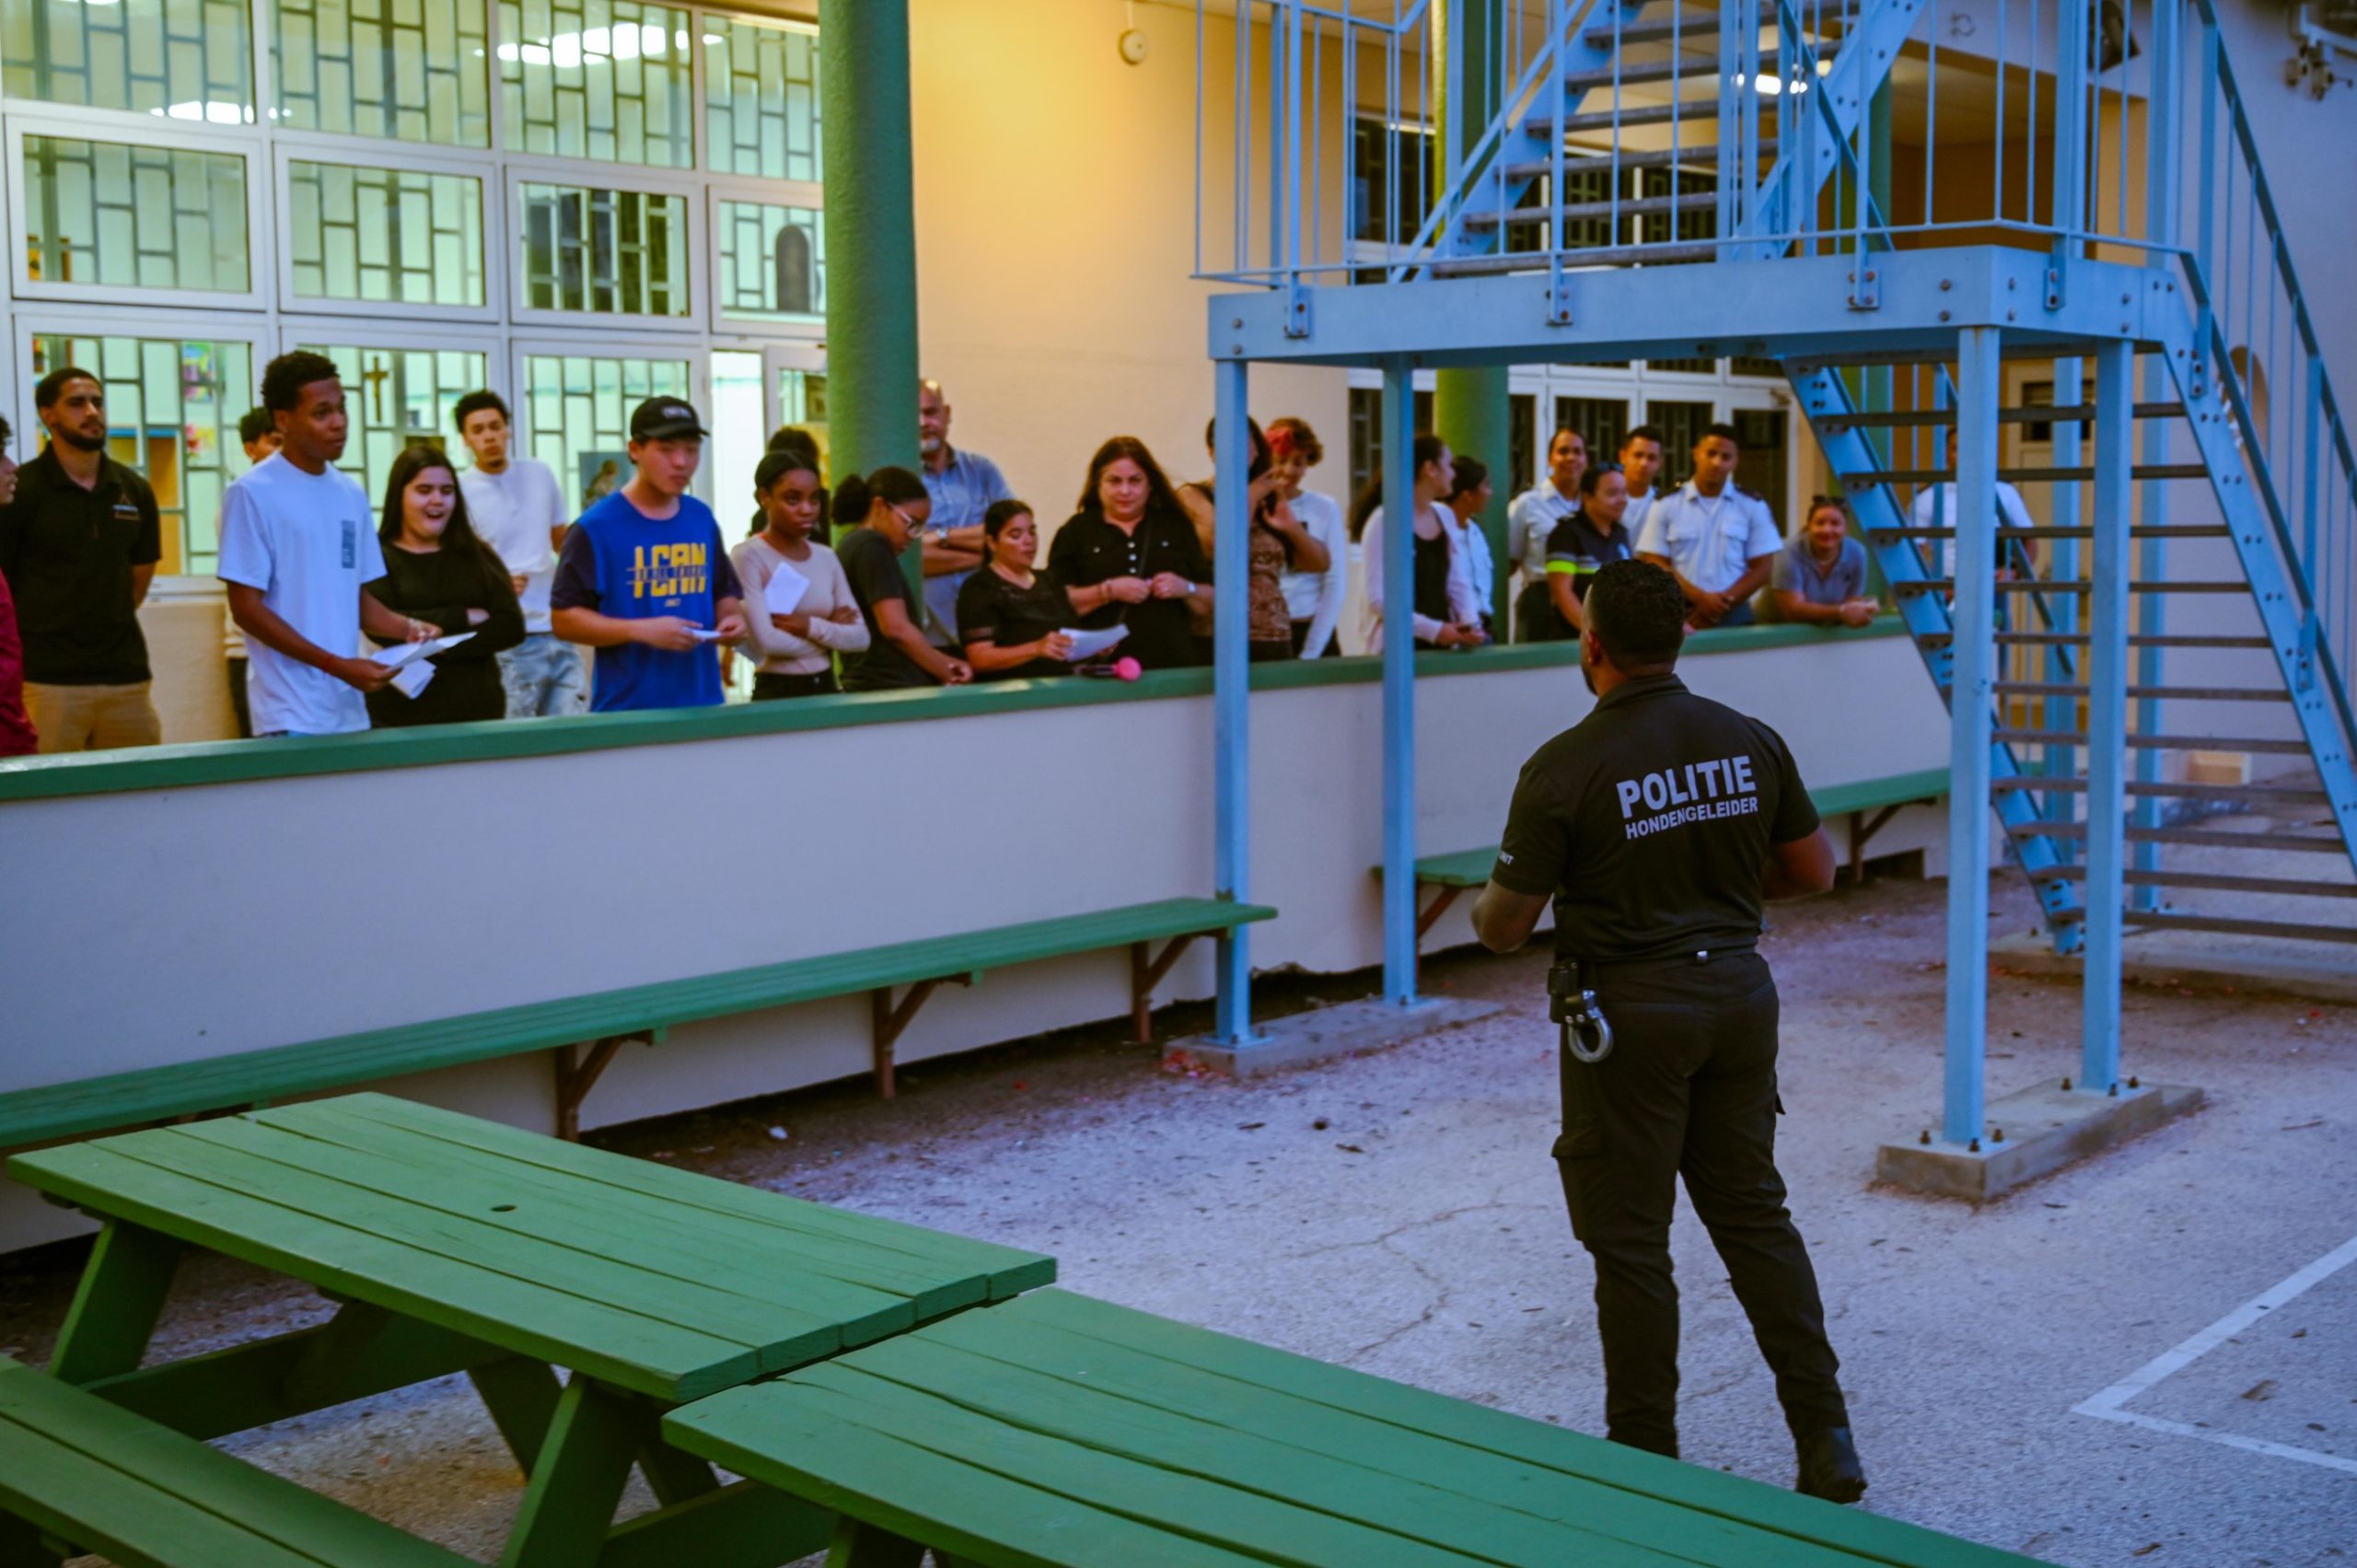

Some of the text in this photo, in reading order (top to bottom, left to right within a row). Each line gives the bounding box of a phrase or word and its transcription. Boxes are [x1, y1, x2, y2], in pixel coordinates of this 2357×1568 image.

[633, 541, 706, 598] I CAN
[1616, 755, 1757, 819] POLITIE
[1625, 796, 1759, 840] HONDENGELEIDER
